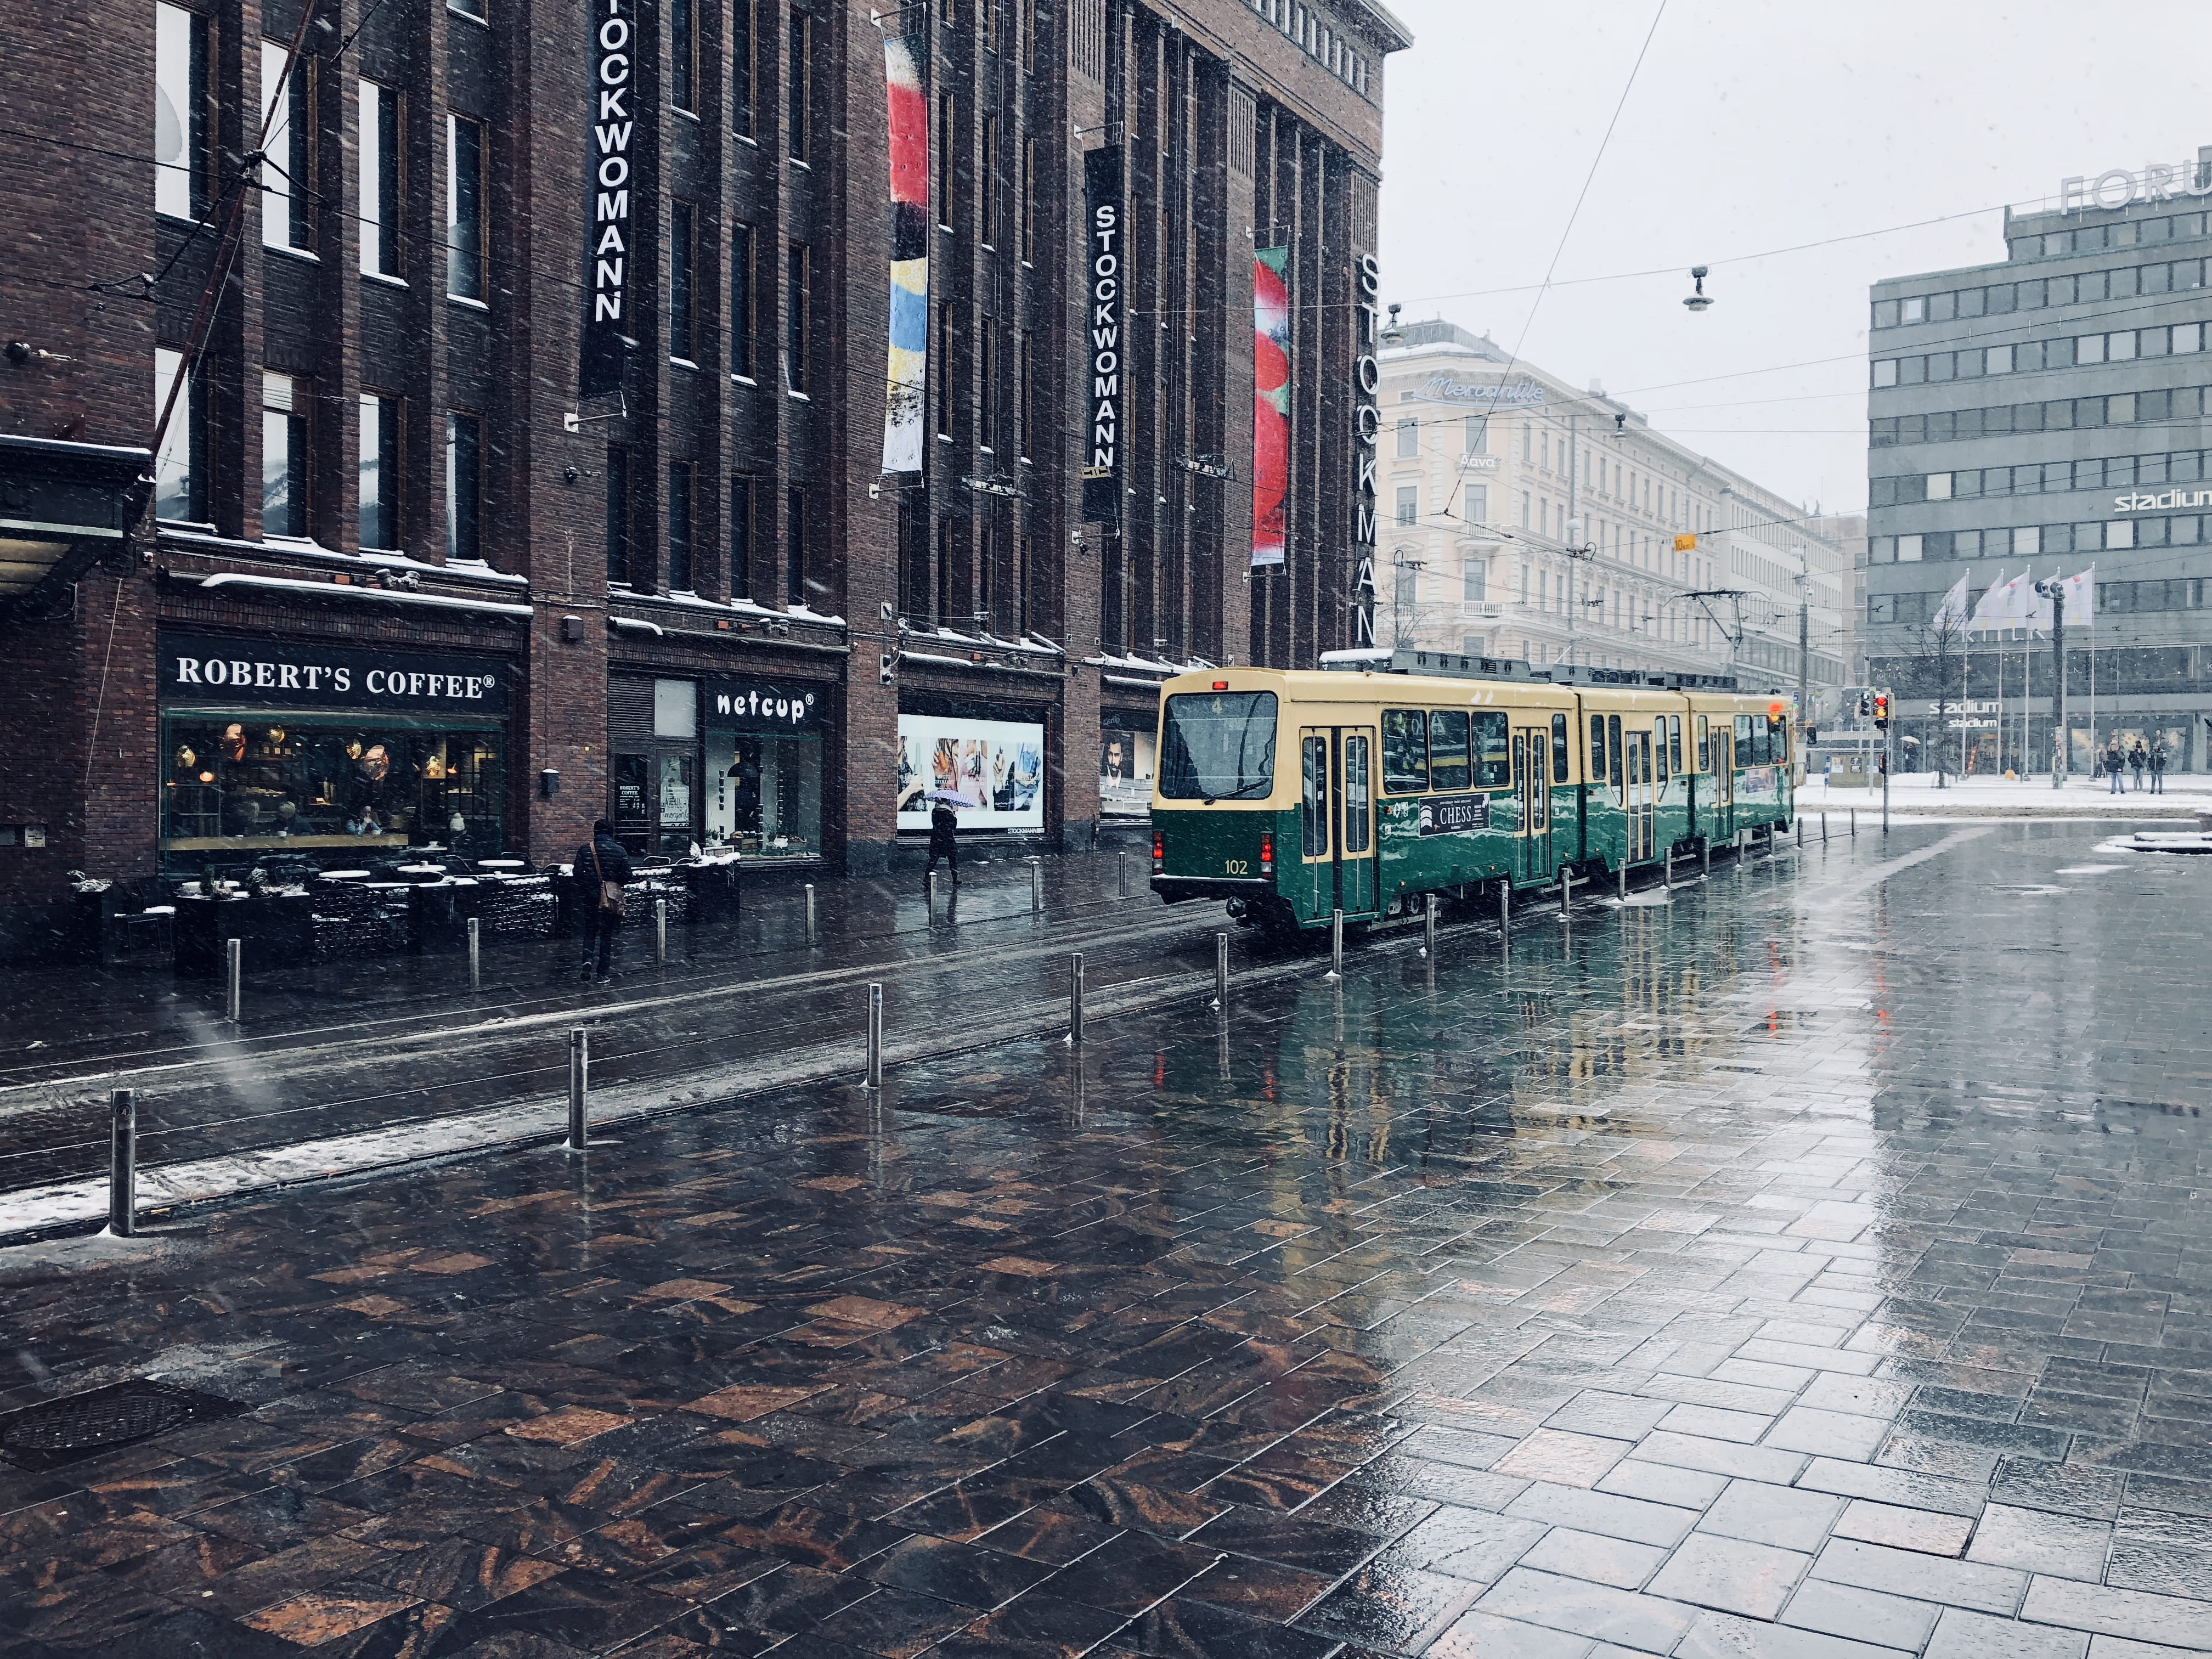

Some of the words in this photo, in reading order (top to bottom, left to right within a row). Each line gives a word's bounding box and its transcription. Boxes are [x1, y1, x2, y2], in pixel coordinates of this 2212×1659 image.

[1092, 205, 1118, 467] STOCKWOMANN
[1413, 376, 1546, 407] Mercantile
[1460, 454, 1496, 467] Aava
[1675, 540, 1683, 551] 10
[177, 657, 351, 692] ROBERT'S
[1929, 699, 2003, 714] sadium
[1948, 718, 1997, 728] stadium
[1440, 805, 1472, 824] CHESS
[1225, 860, 1248, 874] 102
